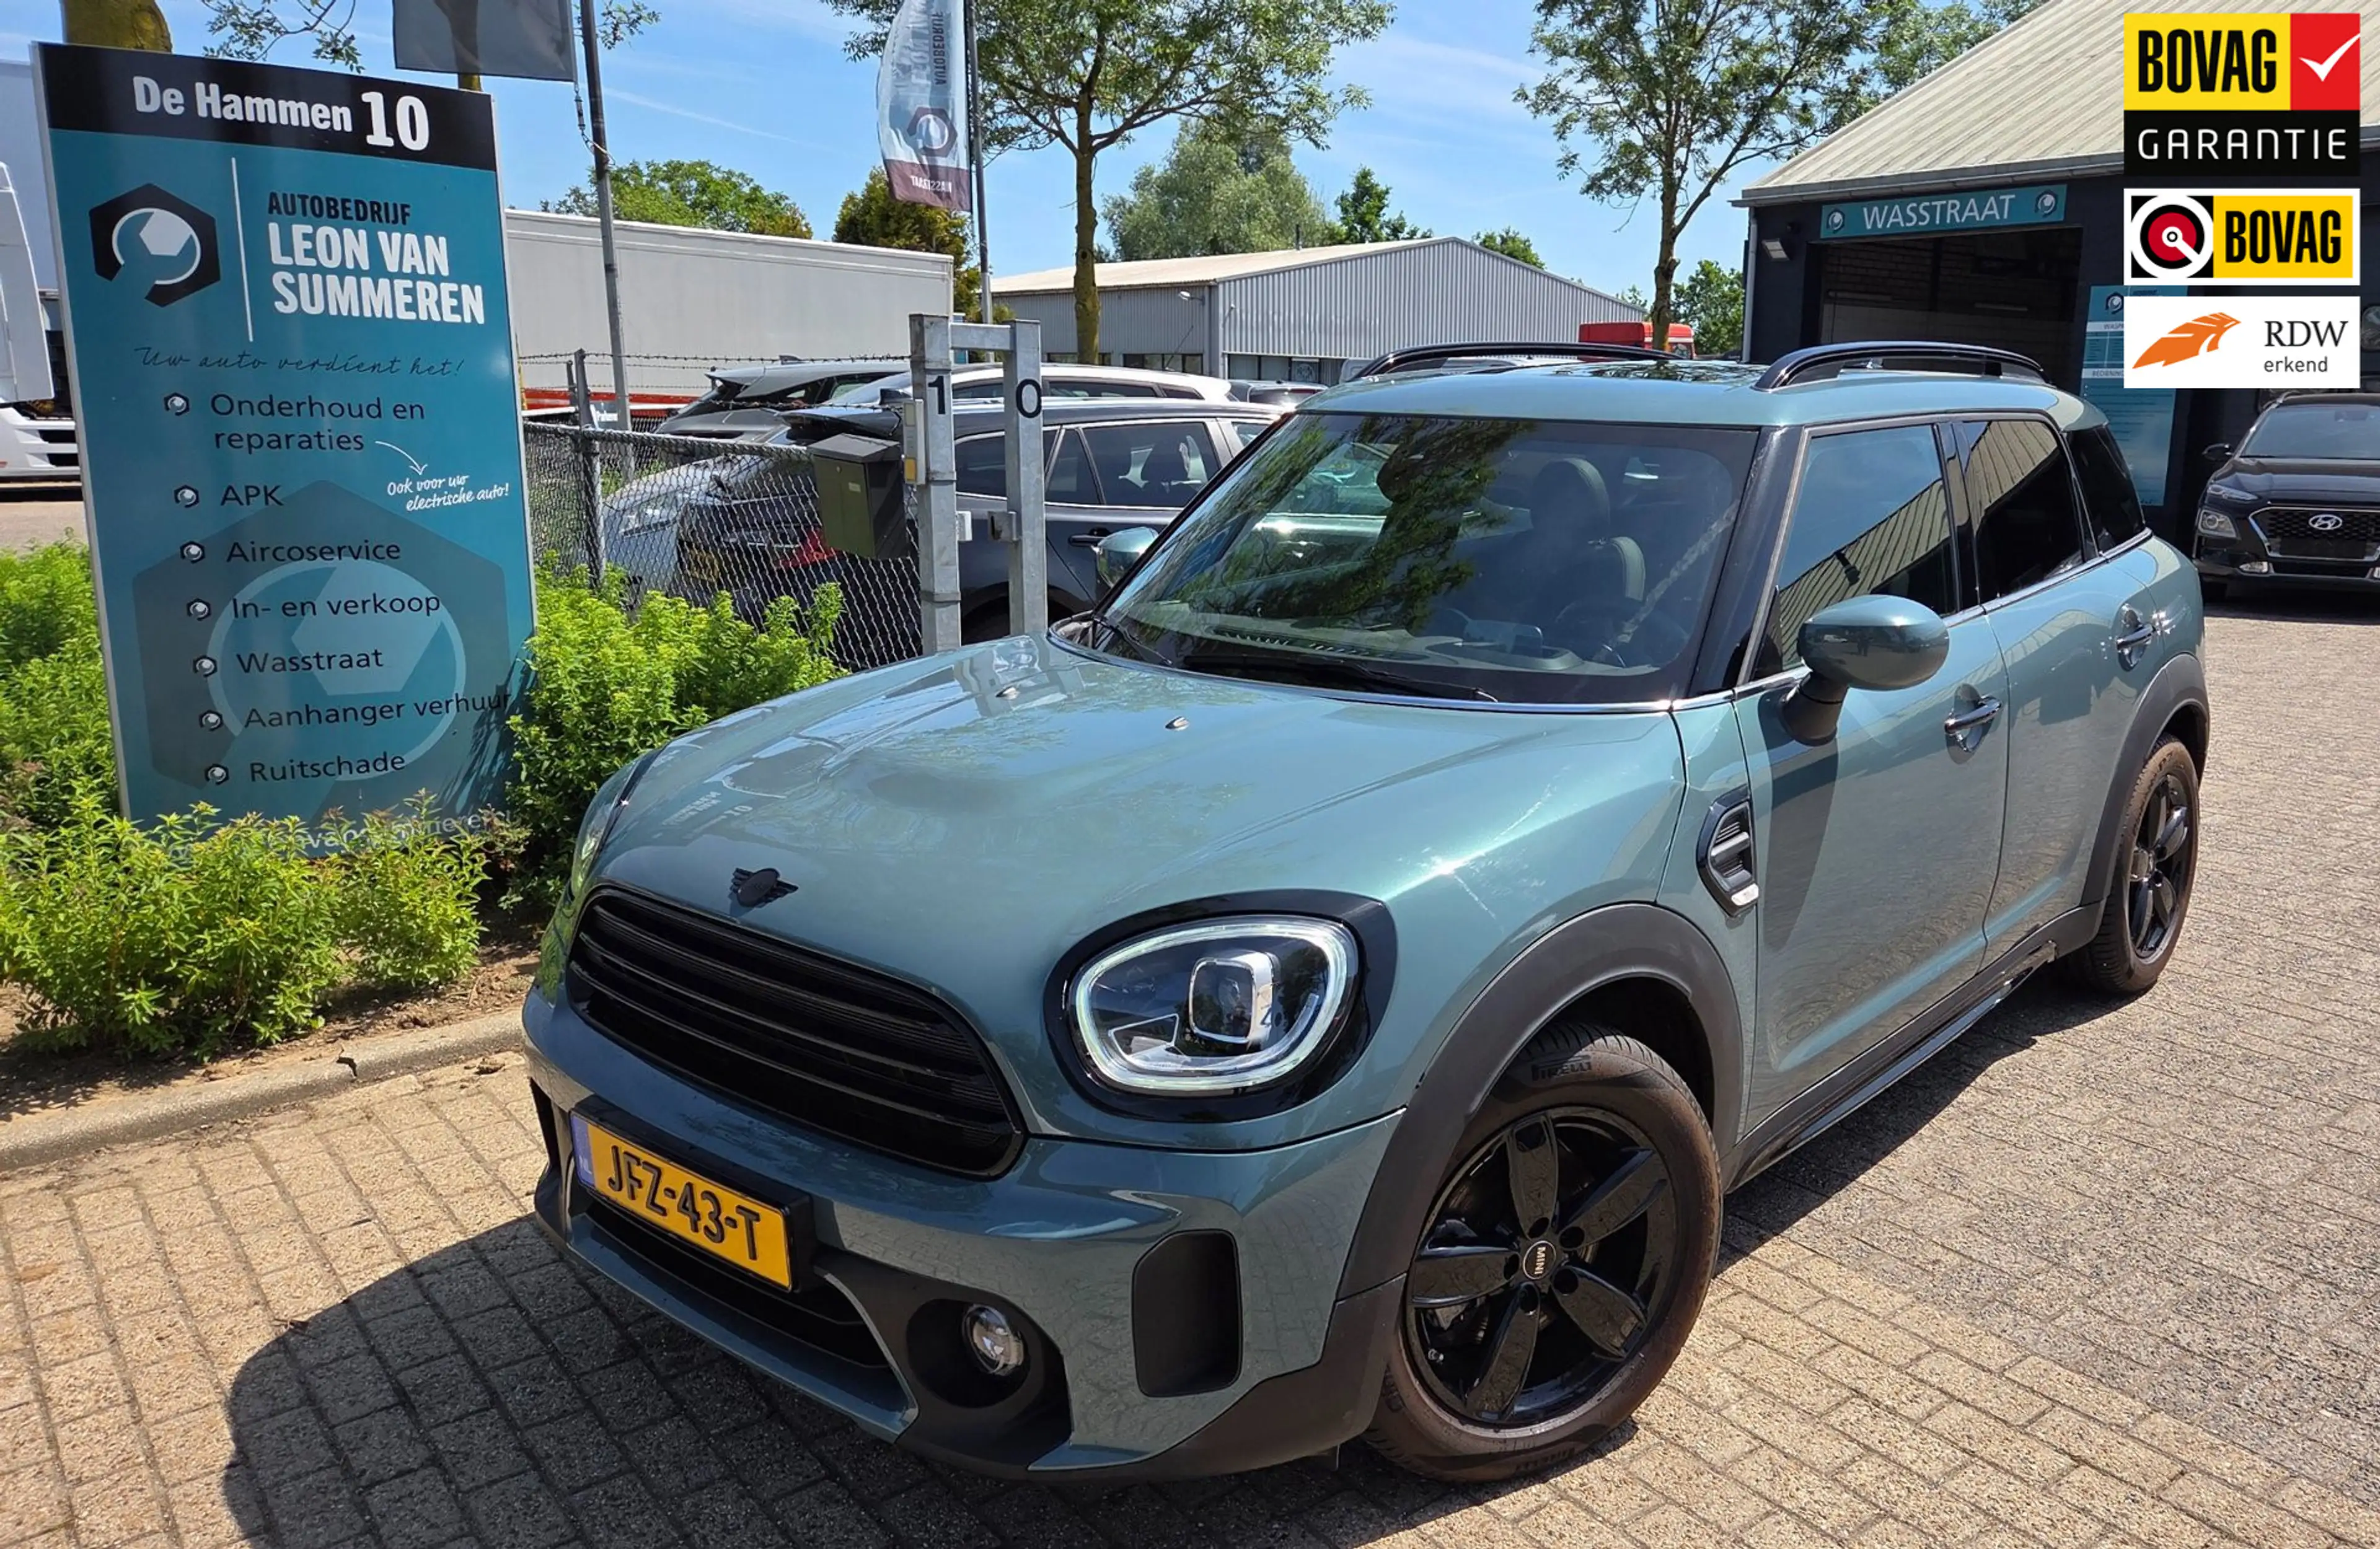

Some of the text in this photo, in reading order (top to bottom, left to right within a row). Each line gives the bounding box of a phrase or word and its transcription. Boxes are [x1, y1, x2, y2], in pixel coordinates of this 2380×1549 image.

[133, 76, 430, 151] De Hammen 10
[268, 191, 411, 226] AUTOBEDRIJF
[1862, 194, 2016, 230] WASSTRAAT
[268, 222, 449, 277] LEON VAN
[271, 271, 485, 325] SUMMEREN
[134, 346, 465, 376] Uw auto verdient het!
[211, 394, 425, 419] Onderhoud en
[928, 375, 1042, 418] 1 0
[215, 429, 364, 454] reparaties
[220, 485, 284, 506] APK
[387, 475, 470, 496] Ook voor uw
[406, 483, 509, 512] electrische auto!
[226, 539, 401, 563] Aircoservice
[232, 592, 441, 618] In- en verkoop
[236, 649, 384, 674] Wasstraat
[244, 692, 512, 728] Aanhanger verhuur
[250, 752, 406, 782] Ruitschade
[607, 1144, 761, 1261] JFZ-43-T
[1533, 1246, 1546, 1275] MINI
